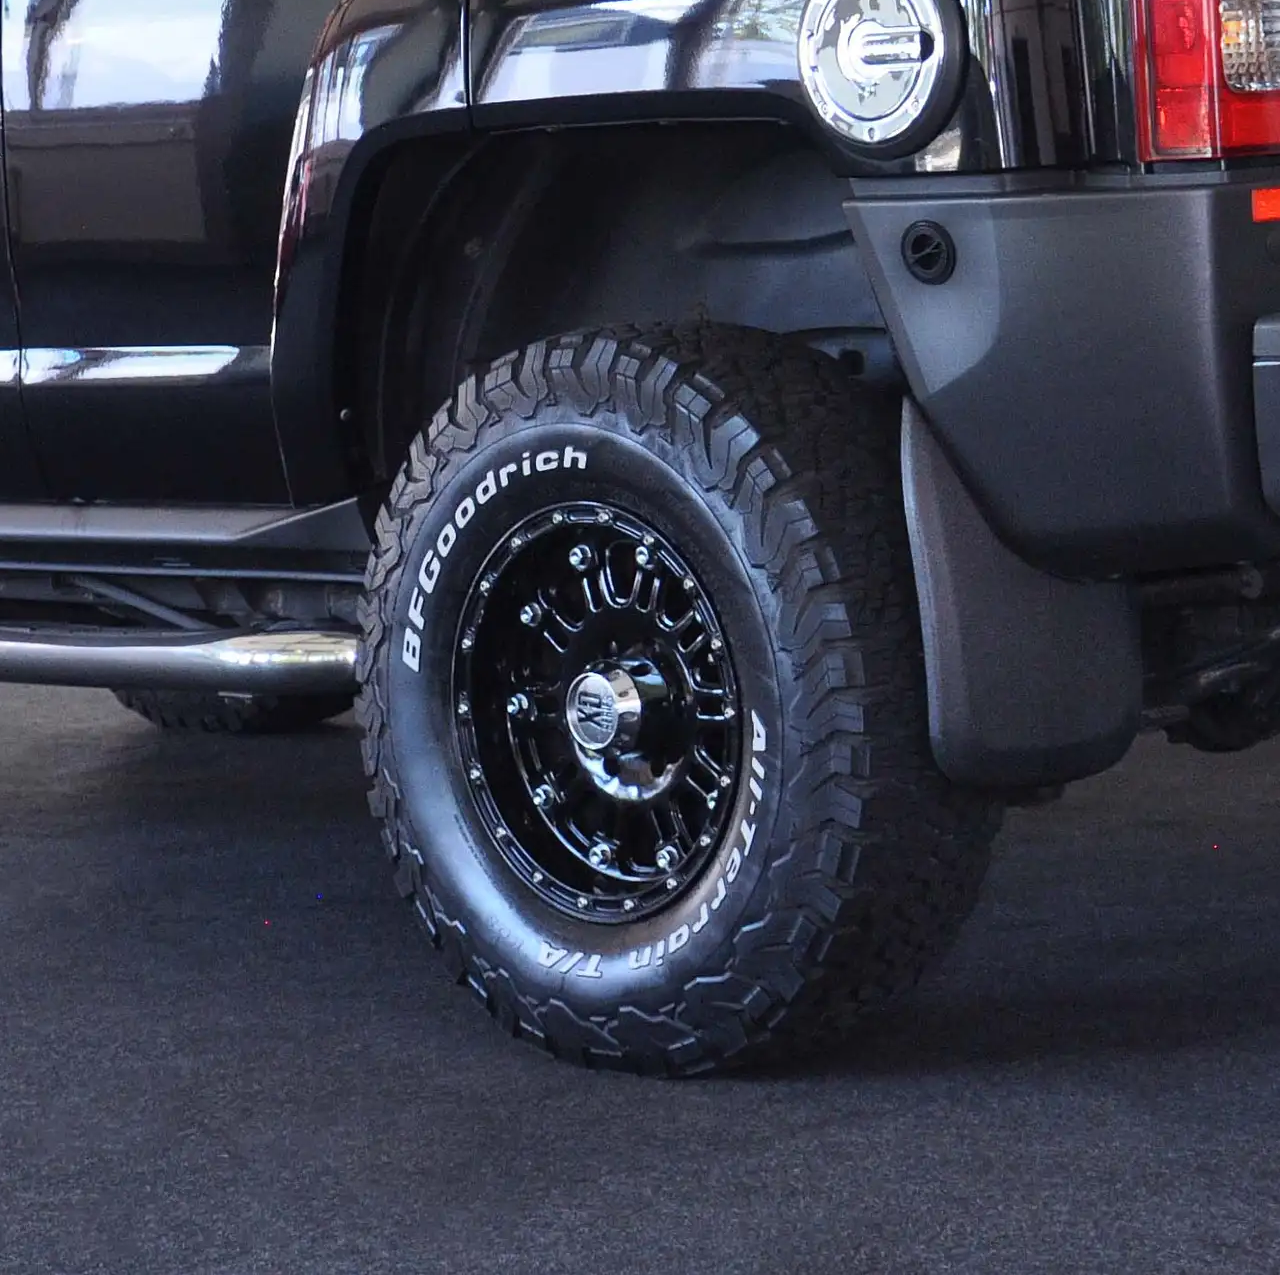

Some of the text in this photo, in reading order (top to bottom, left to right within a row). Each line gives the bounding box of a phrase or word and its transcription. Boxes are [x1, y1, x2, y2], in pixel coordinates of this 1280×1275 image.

[402, 446, 588, 673] BFGoodrich
[627, 708, 766, 971] All-Terrain
[536, 941, 604, 979] T/A
